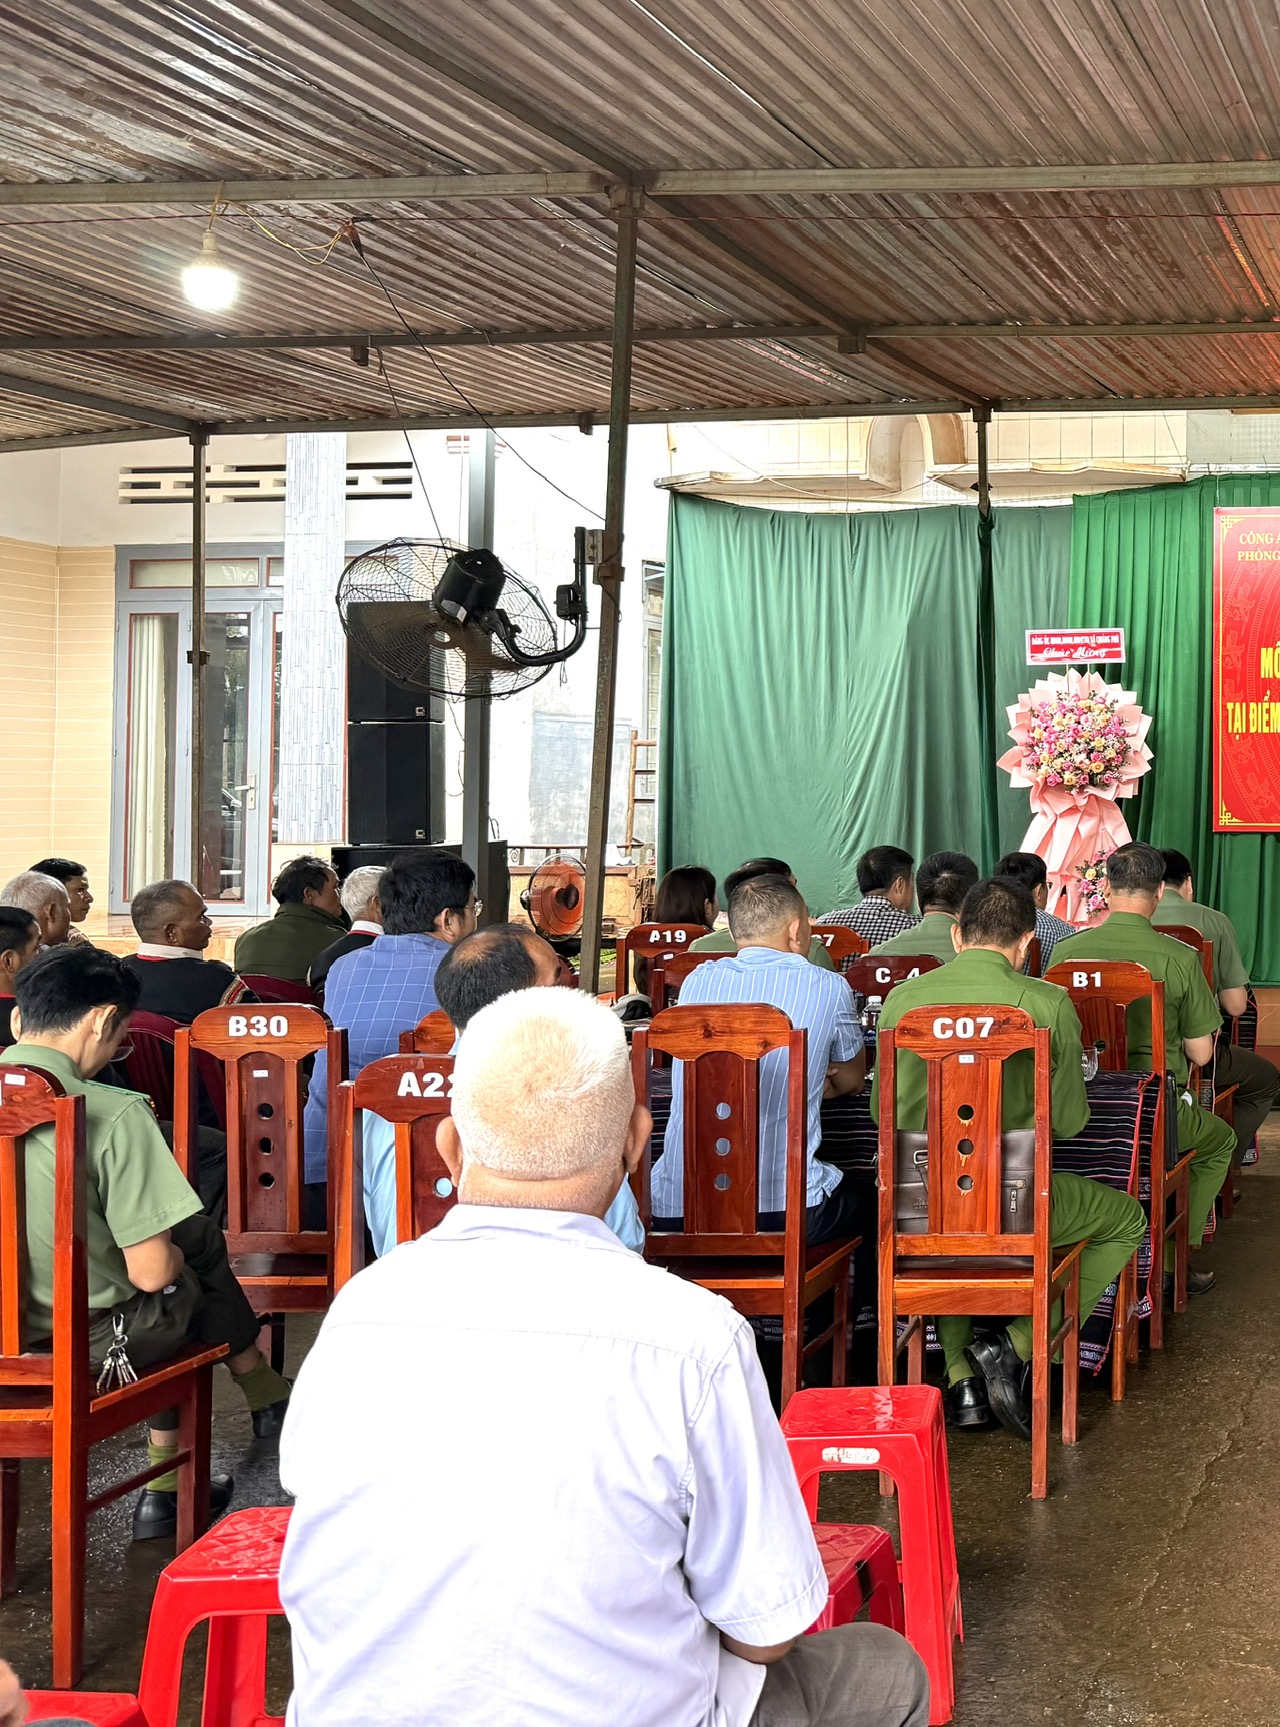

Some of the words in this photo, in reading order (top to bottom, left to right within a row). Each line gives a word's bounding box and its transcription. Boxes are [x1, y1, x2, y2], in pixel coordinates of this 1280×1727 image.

[1239, 531, 1274, 545] CÔNG
[1237, 548, 1280, 561] PHÒNG
[1226, 702, 1246, 740] TẠI
[1248, 689, 1280, 733] ĐIỂM
[649, 929, 687, 943] A19
[228, 1015, 289, 1037] B30
[933, 1016, 995, 1039] C07
